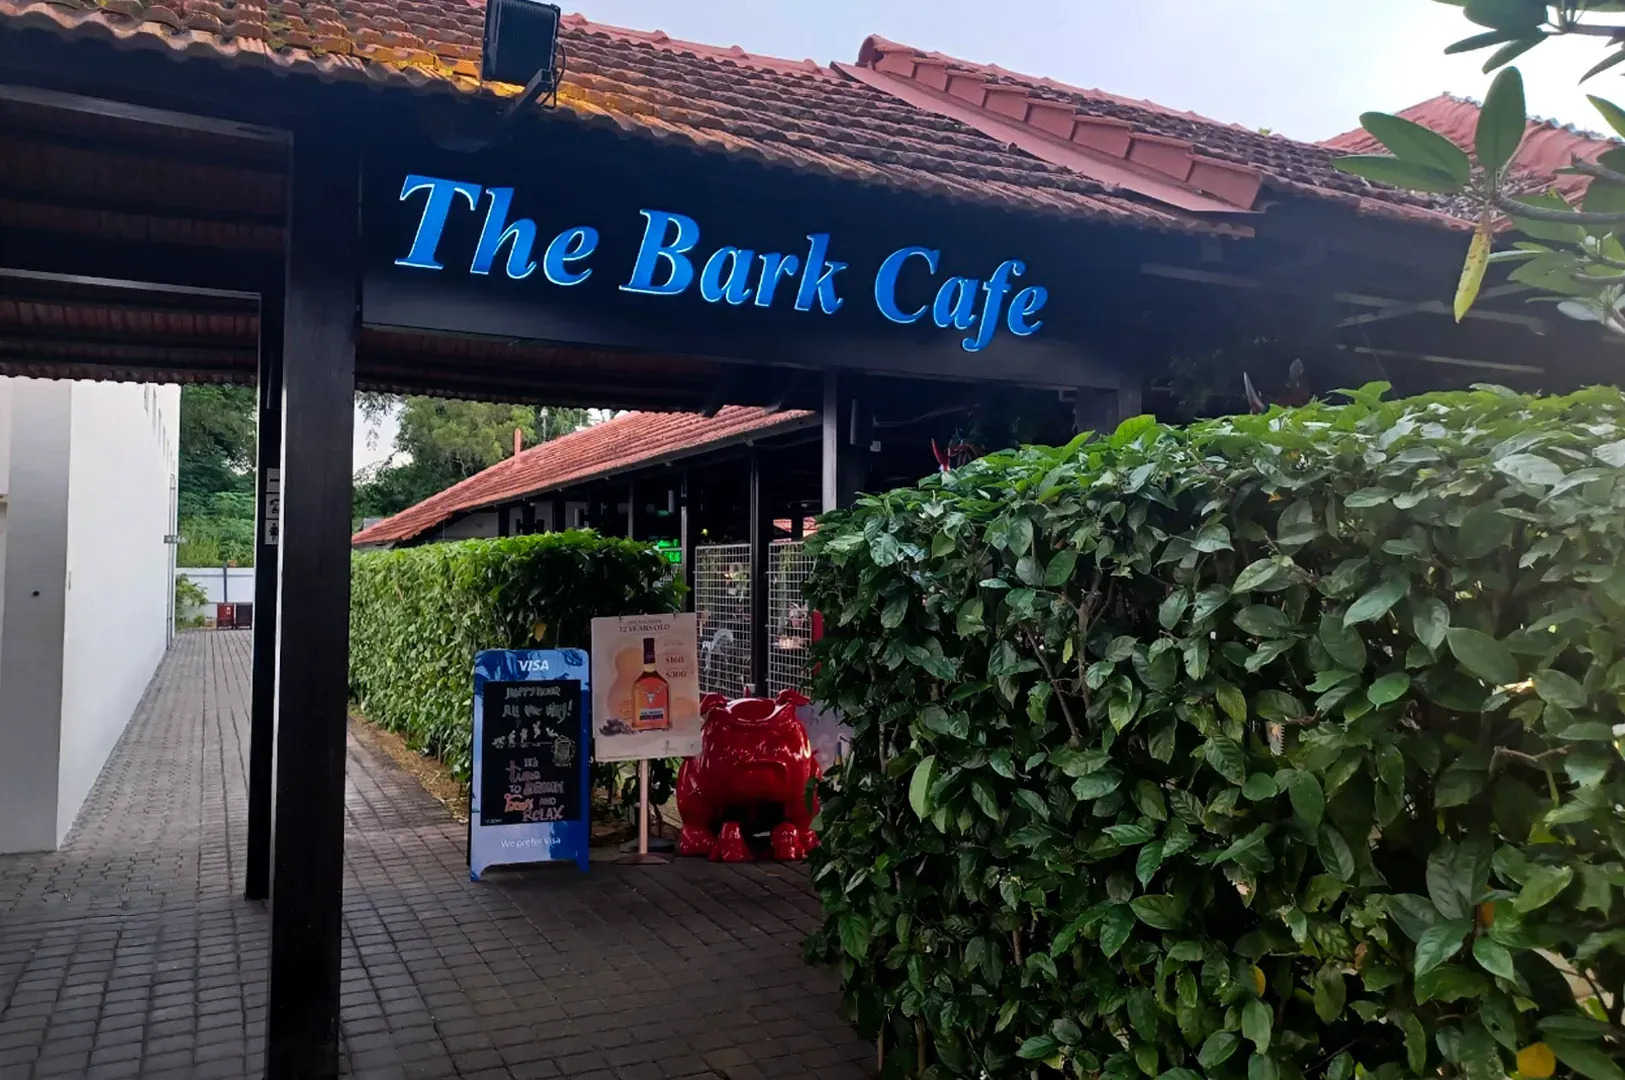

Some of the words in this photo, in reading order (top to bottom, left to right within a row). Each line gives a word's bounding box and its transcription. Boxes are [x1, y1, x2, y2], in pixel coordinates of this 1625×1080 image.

[394, 174, 600, 286] The
[618, 208, 849, 314] Bark
[874, 245, 1048, 352] Cafe
[628, 624, 653, 632] YEARS
[518, 659, 550, 671] VISA
[500, 839, 516, 848] We
